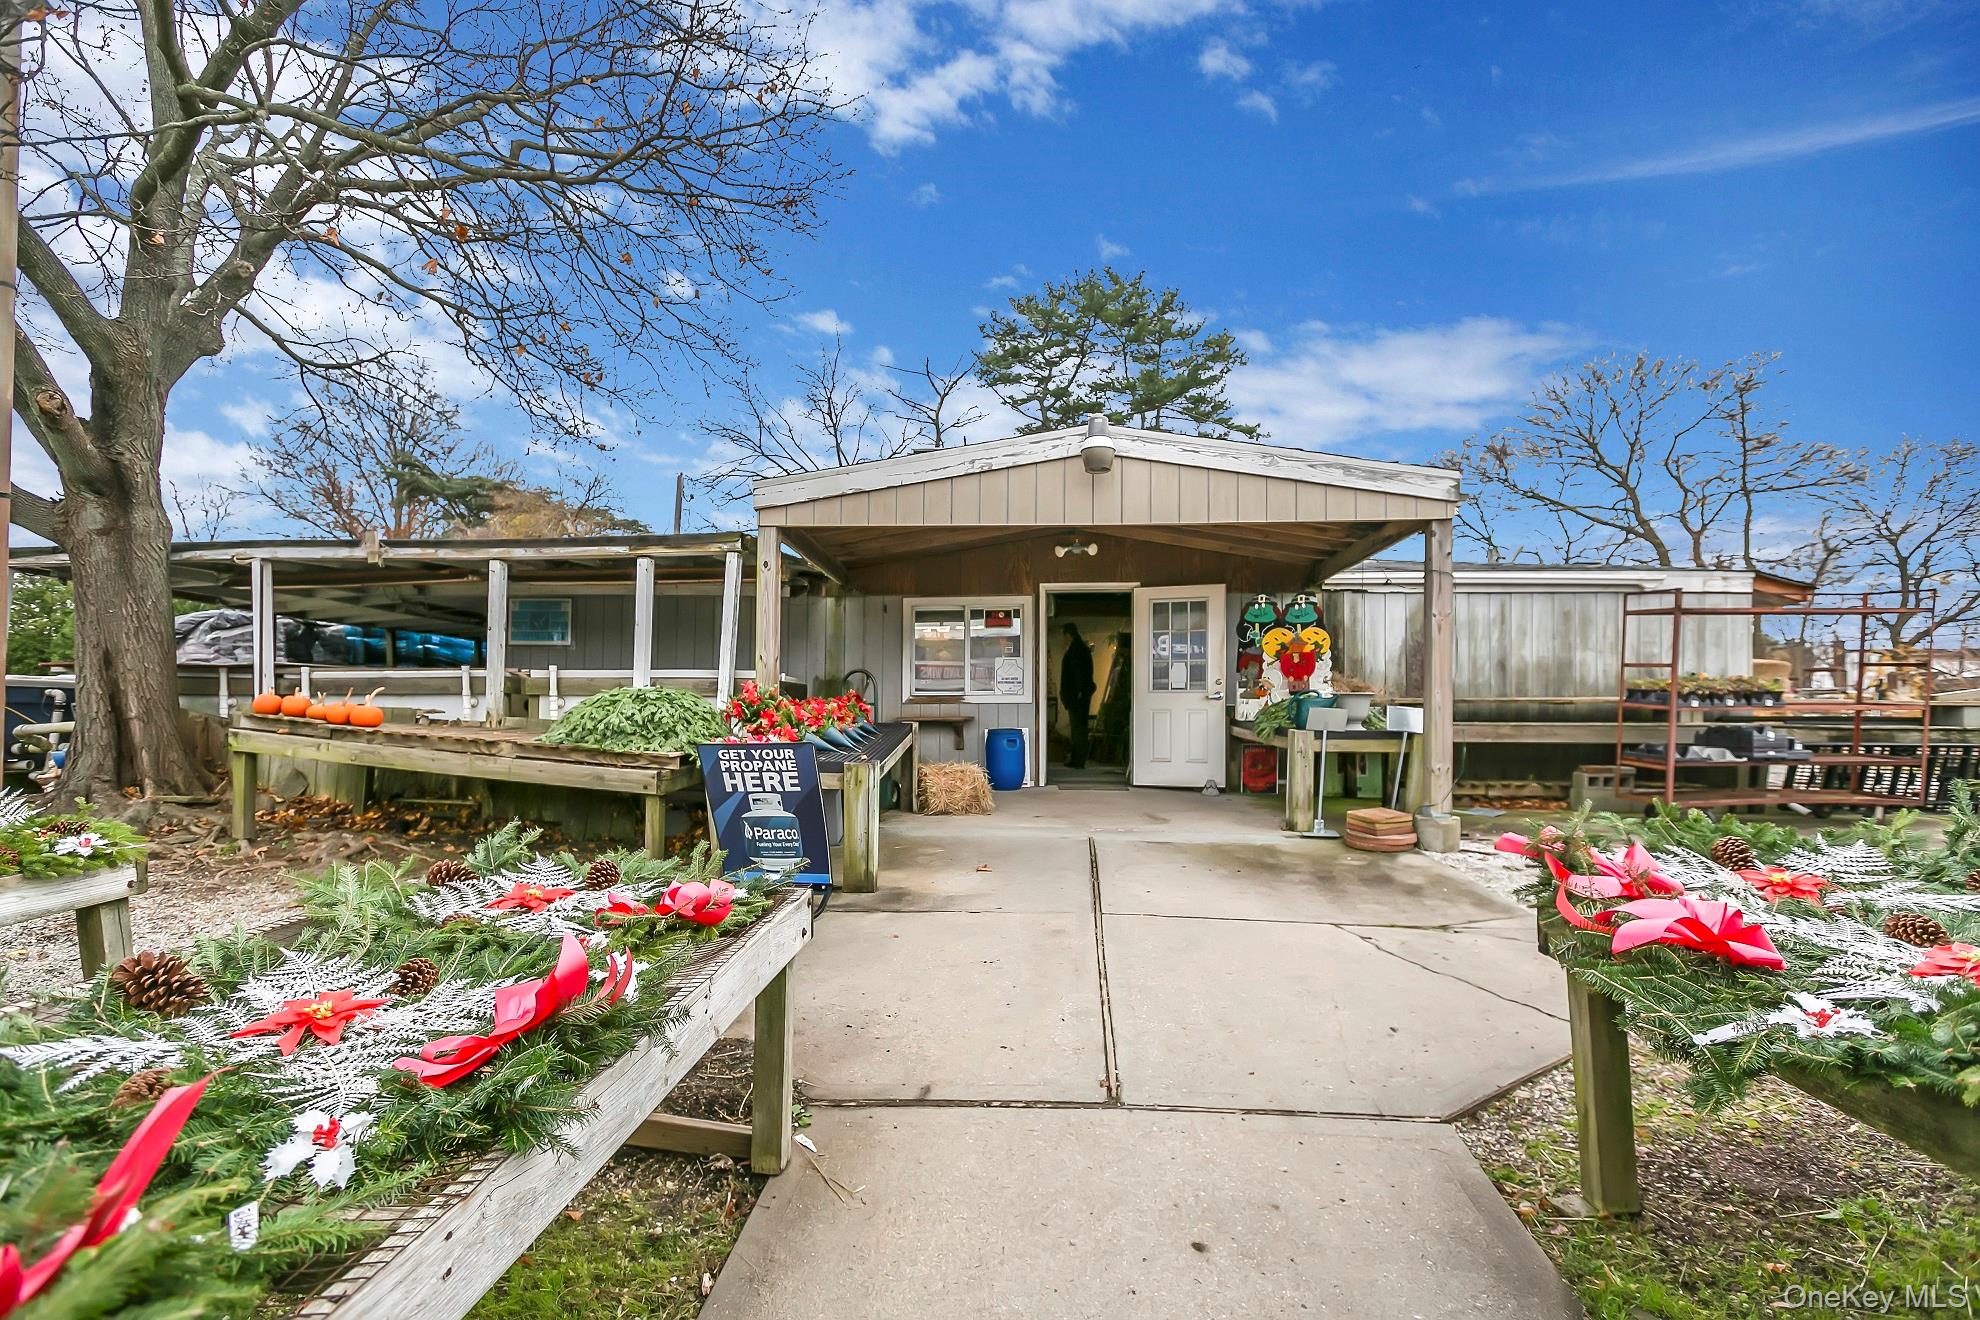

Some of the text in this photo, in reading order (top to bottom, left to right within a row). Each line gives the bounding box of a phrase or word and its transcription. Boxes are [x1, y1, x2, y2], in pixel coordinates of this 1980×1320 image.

[718, 749, 795, 760] GET YOUR
[720, 760, 798, 771] PROPANE
[722, 772, 801, 792] HERE
[753, 826, 798, 840] Paraco
